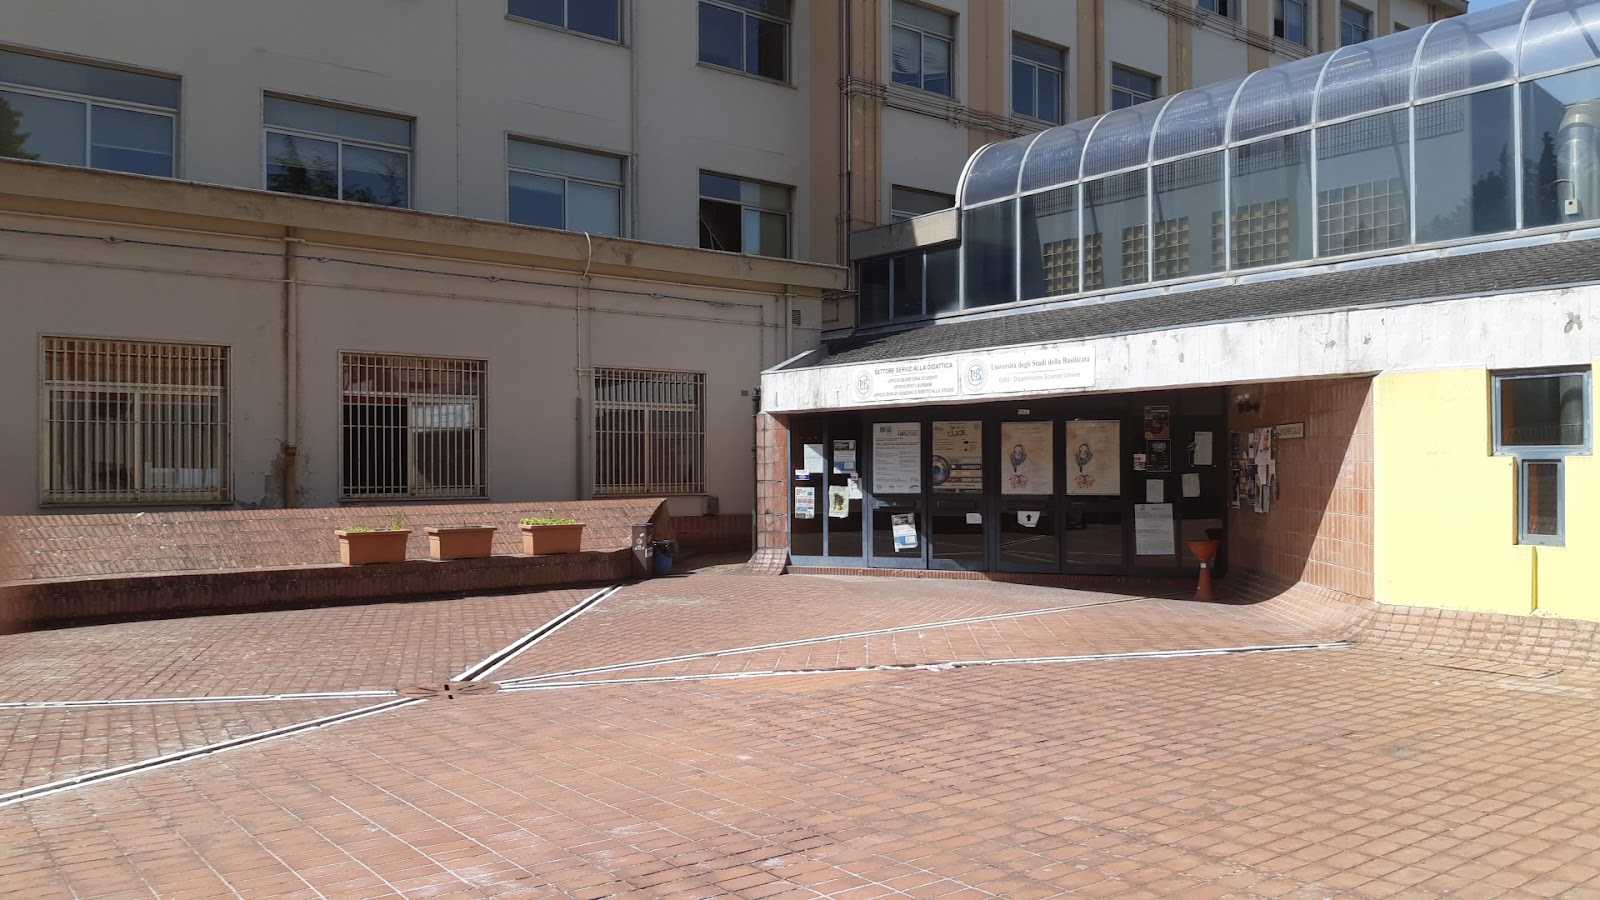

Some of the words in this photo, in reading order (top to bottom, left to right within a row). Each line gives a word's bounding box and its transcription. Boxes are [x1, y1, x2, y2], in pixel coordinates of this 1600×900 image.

[991, 362, 1017, 370] Università
[1018, 360, 1031, 369] degli
[1032, 359, 1046, 367] Studi
[1048, 358, 1061, 366] della
[1062, 356, 1090, 364] Basilicata
